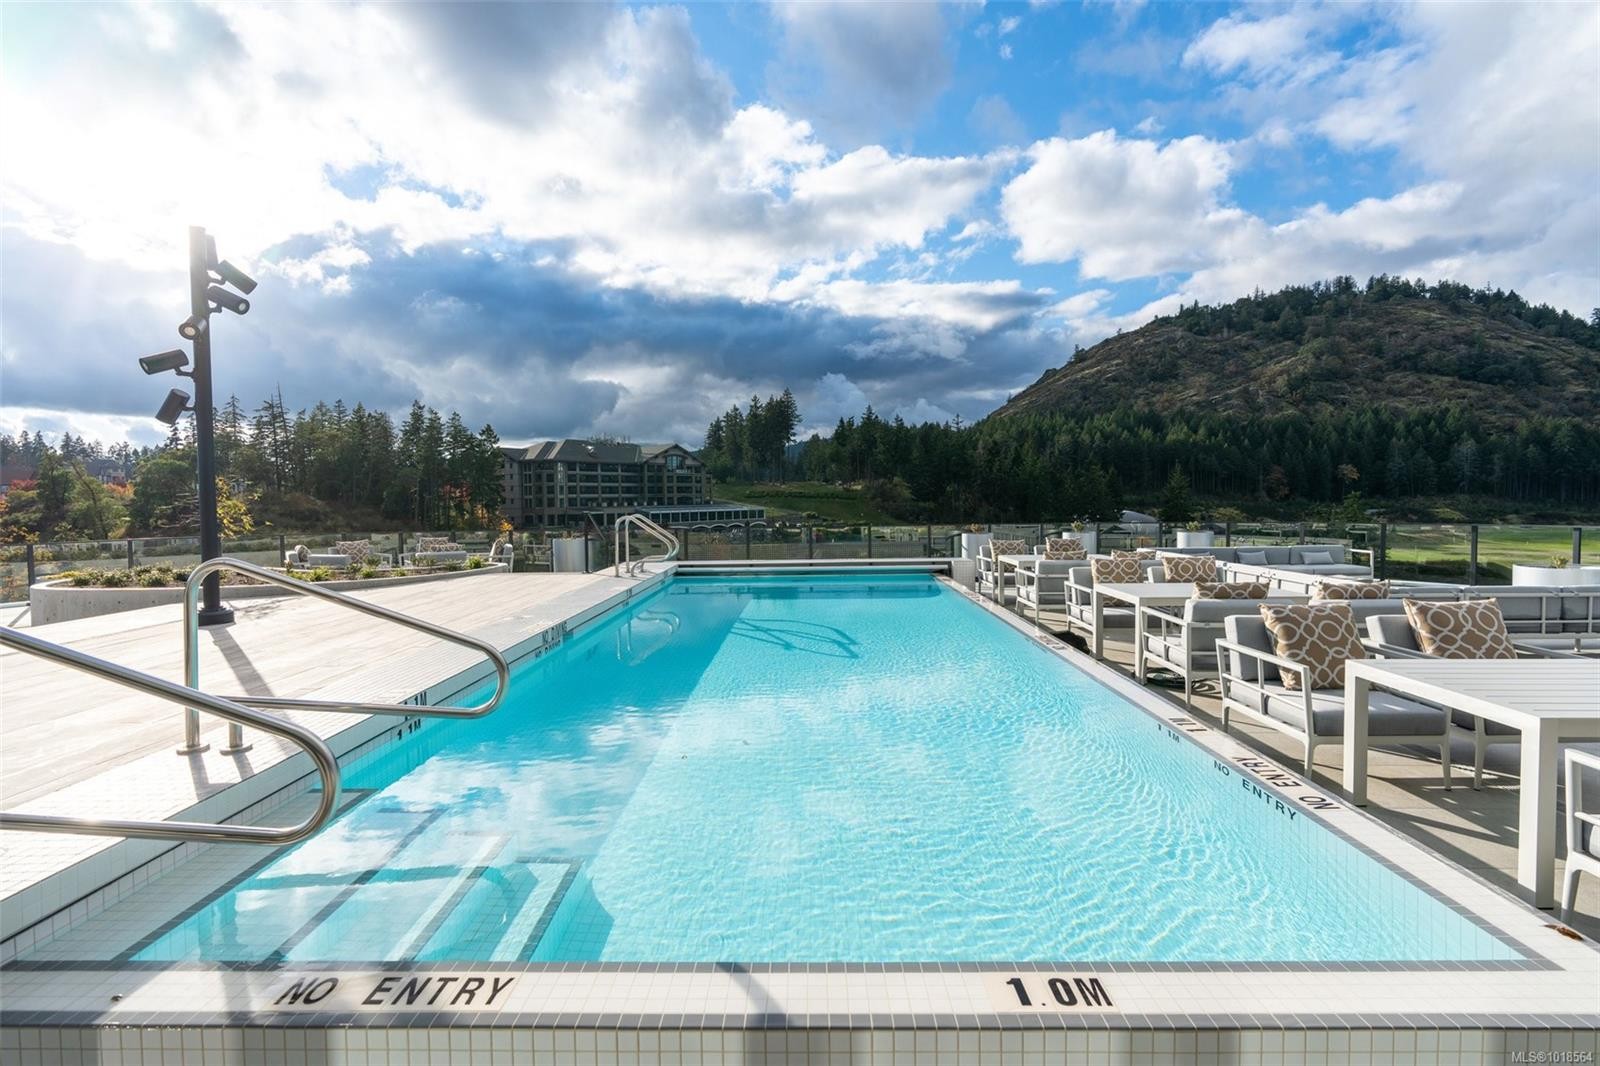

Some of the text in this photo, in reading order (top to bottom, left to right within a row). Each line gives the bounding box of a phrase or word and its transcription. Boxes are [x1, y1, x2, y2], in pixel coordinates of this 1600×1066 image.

[1214, 760, 1297, 821] NO ENTRY
[1232, 756, 1340, 810] NO ENTRY
[273, 977, 515, 1005] NO ENTRY
[1006, 977, 1113, 1007] 1.0M
